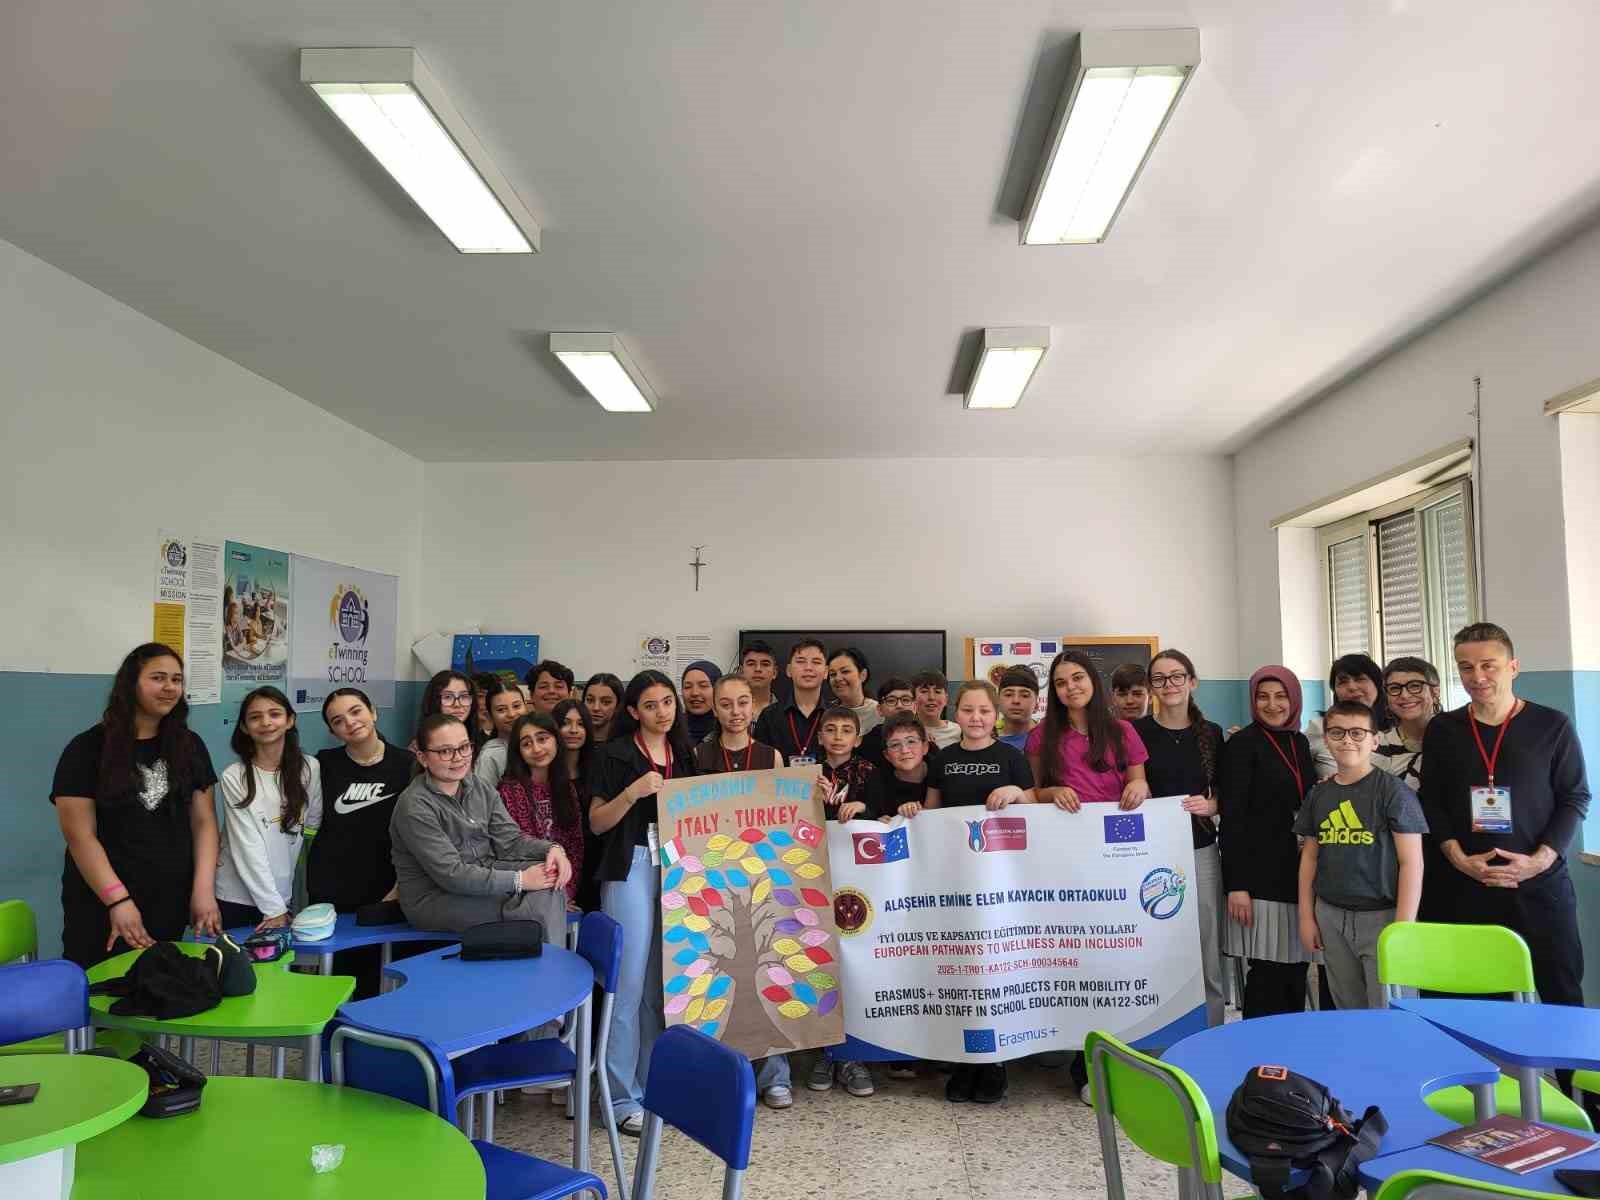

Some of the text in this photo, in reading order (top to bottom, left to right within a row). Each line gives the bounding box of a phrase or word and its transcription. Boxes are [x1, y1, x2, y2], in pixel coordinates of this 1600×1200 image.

[160, 589, 187, 599] MISSION
[328, 642, 368, 665] eTwinning
[328, 666, 367, 683] SCHOOL
[945, 763, 1000, 776] Kappa
[344, 782, 386, 800] NIKE
[673, 803, 799, 838] ITALY TURKEY
[1318, 826, 1375, 845] adidas
[885, 893, 937, 912] ALAŞEHİR
[939, 892, 973, 908] EMİNE
[976, 891, 1004, 906] ELEM
[1008, 888, 1055, 903] KAYACIK
[1058, 888, 1127, 902] ORTAOKULU
[897, 931, 924, 943] OLUŞ
[926, 931, 938, 941] VE
[941, 930, 992, 941] KAPSAYICI
[993, 924, 1041, 939] EĞİTİMDE
[1044, 924, 1086, 935] AVRUPA
[874, 936, 1143, 959] EUROPEAN PATHWAYS TO WELLNESS AND INCLUSION
[875, 978, 1148, 1002] ERASMUS+ SHORT-TERM PROJECTS FOR MOBILITY OF
[865, 993, 1159, 1019] LEARNERS AND STAFF IN SCHOOL EDUCATION (KA122-SCH)
[999, 1026, 1059, 1047] Erasmus+
